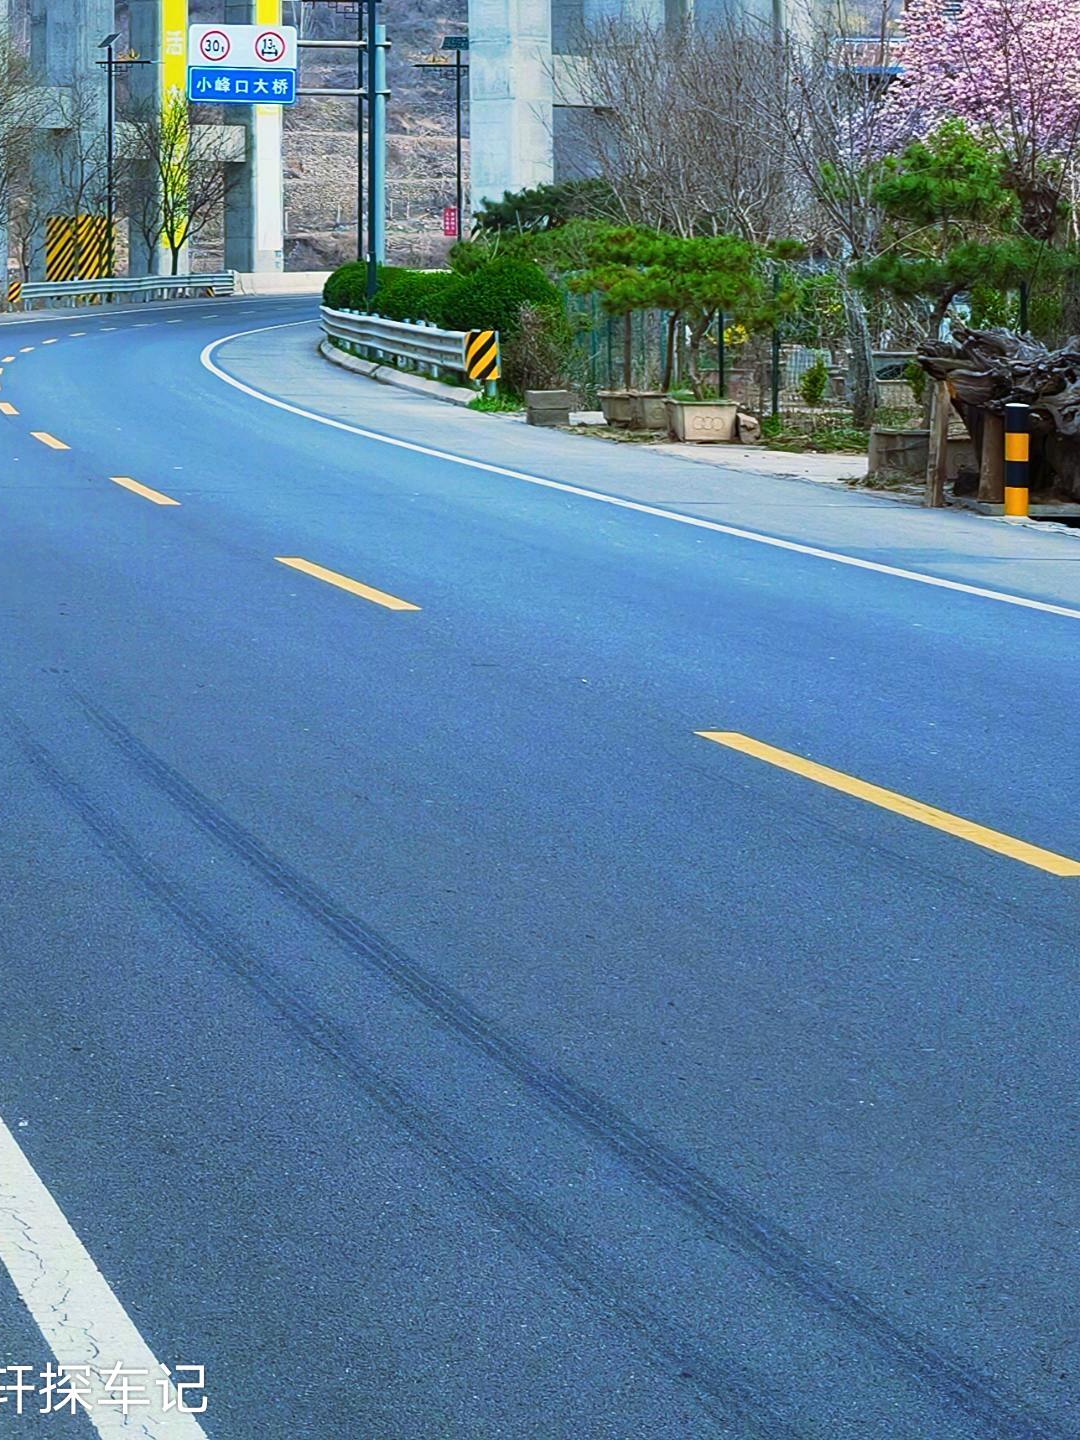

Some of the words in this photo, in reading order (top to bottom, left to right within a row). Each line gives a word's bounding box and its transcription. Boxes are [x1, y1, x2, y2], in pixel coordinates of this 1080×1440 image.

[205, 39, 224, 52] 30t
[196, 76, 289, 95] 小峰口大桥
